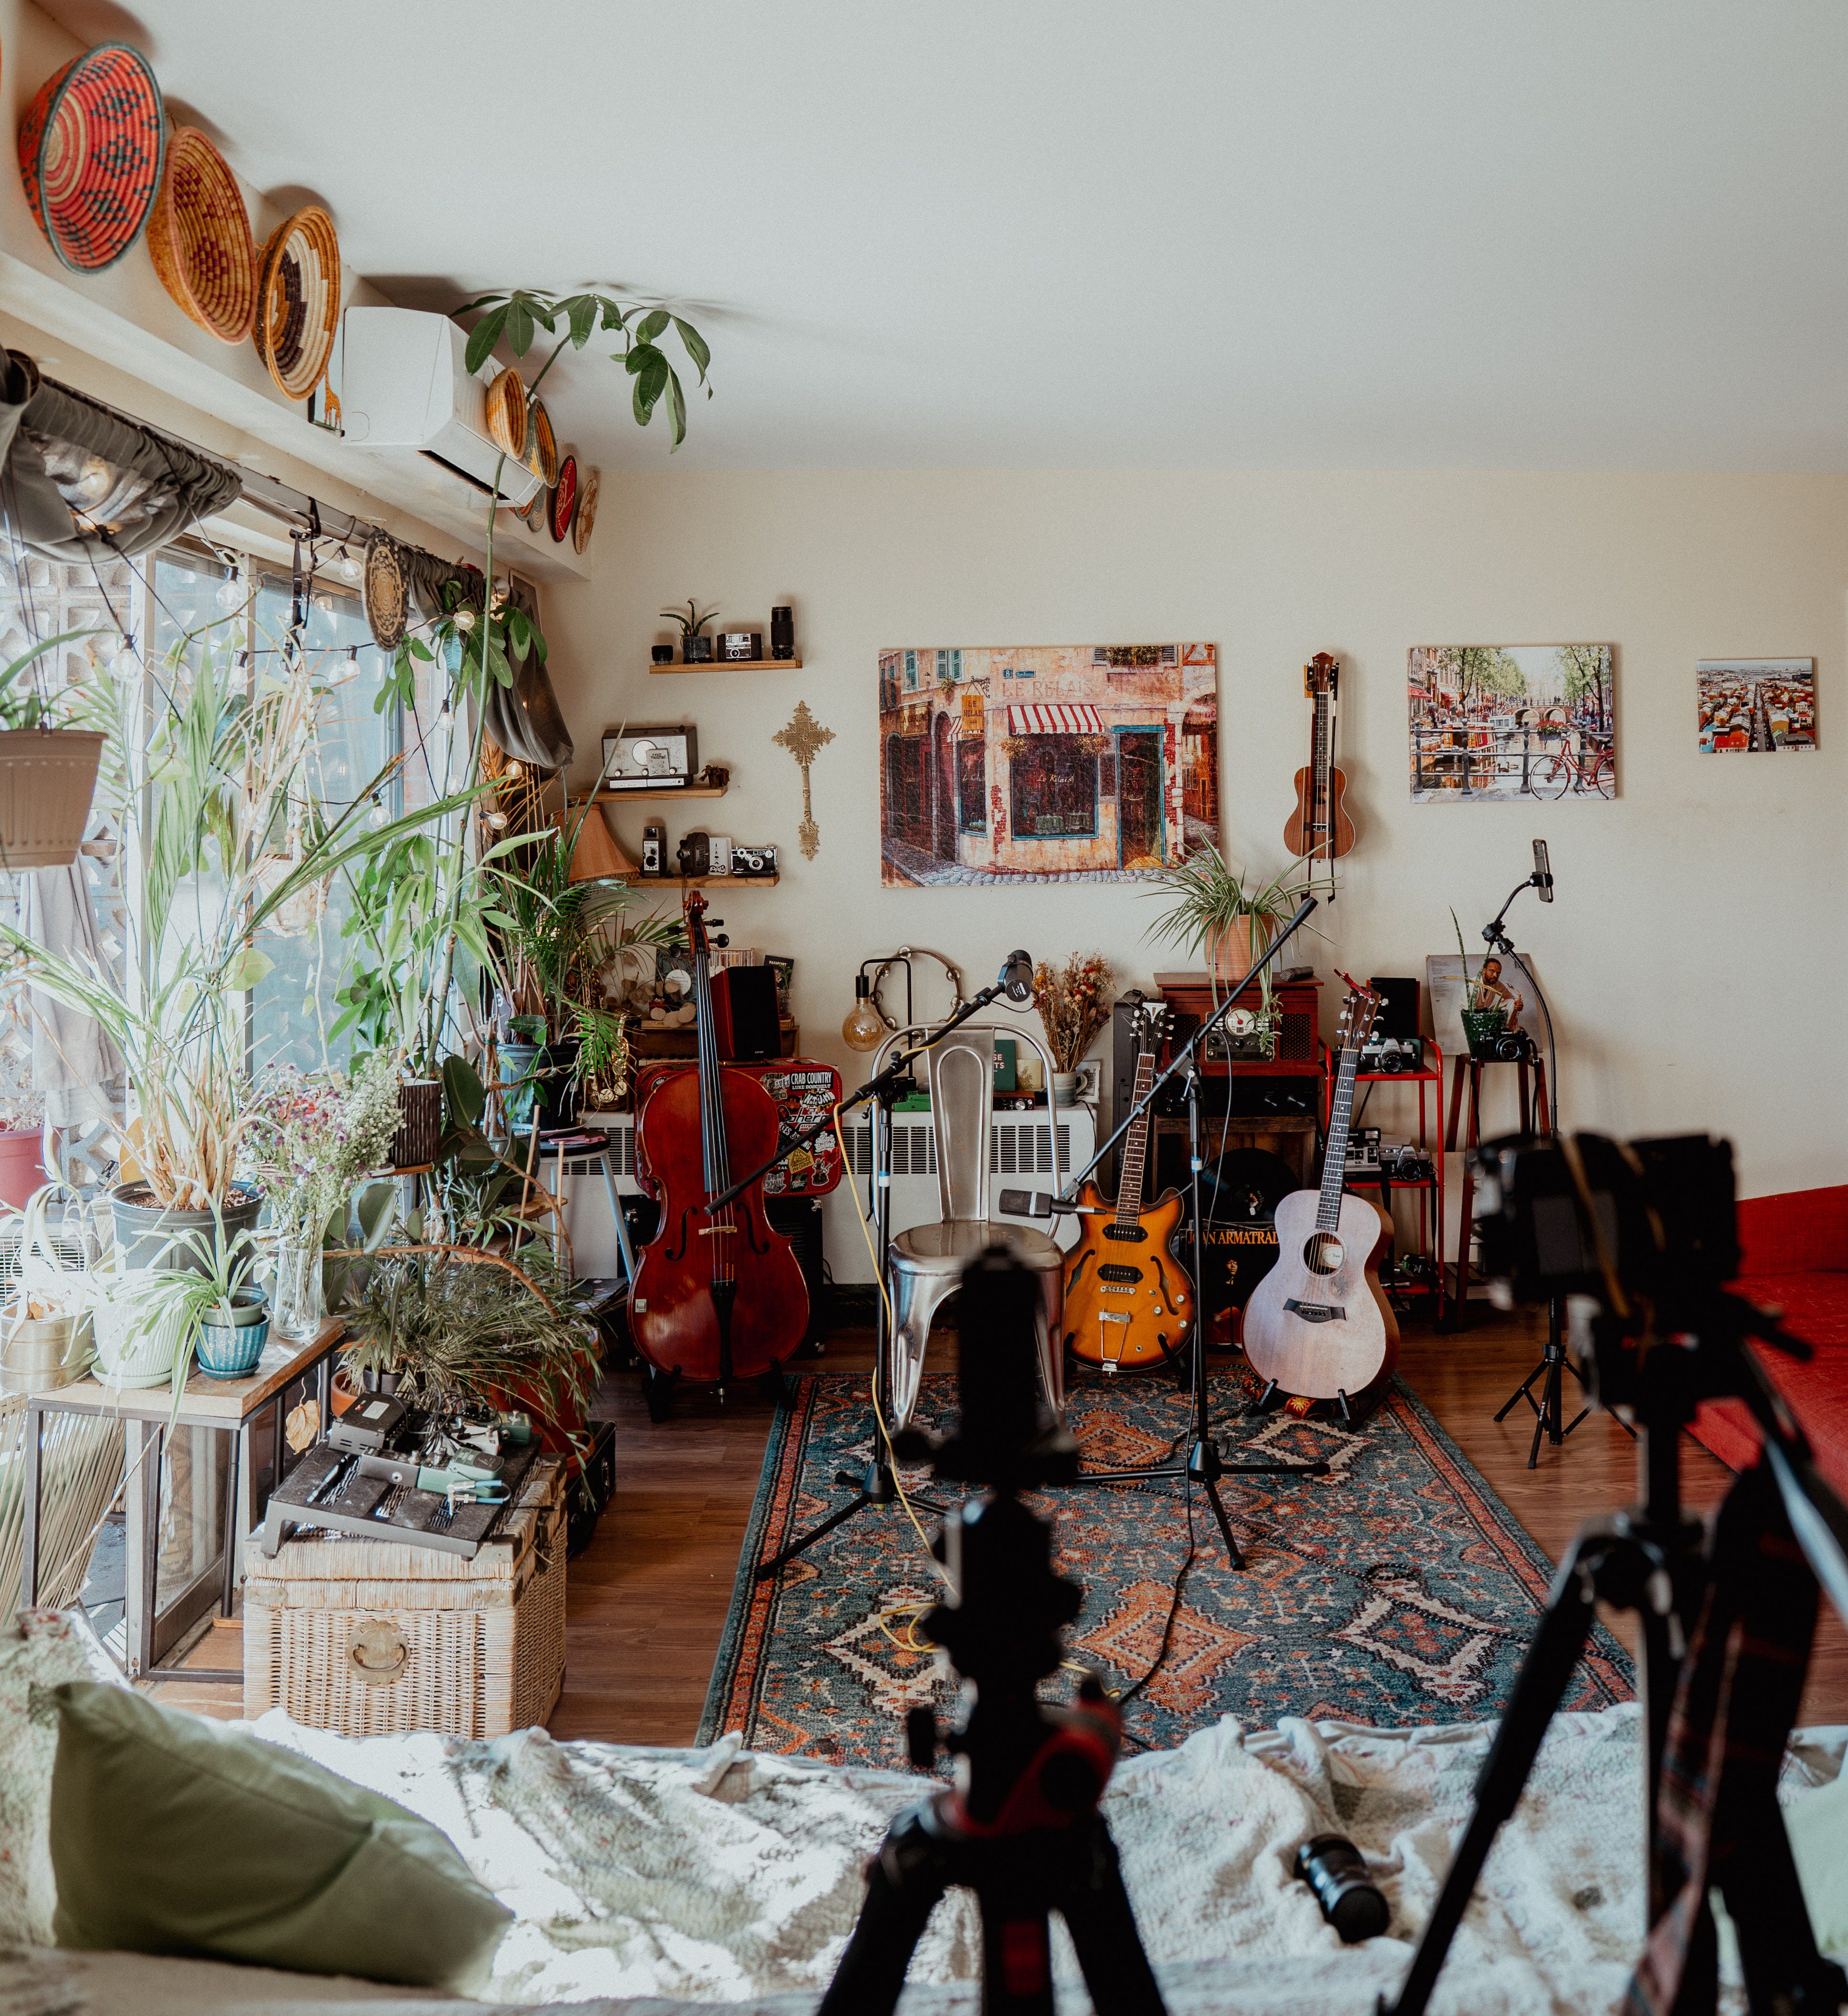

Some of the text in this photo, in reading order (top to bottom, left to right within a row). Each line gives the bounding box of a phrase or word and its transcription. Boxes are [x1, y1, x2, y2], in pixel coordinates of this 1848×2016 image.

[1002, 681, 1093, 697] LE RELAIS
[1050, 774, 1073, 783] Relais
[791, 1072, 806, 1085] CRAB
[807, 1072, 832, 1084] COUNTRY
[792, 1161, 812, 1172] RECORDS
